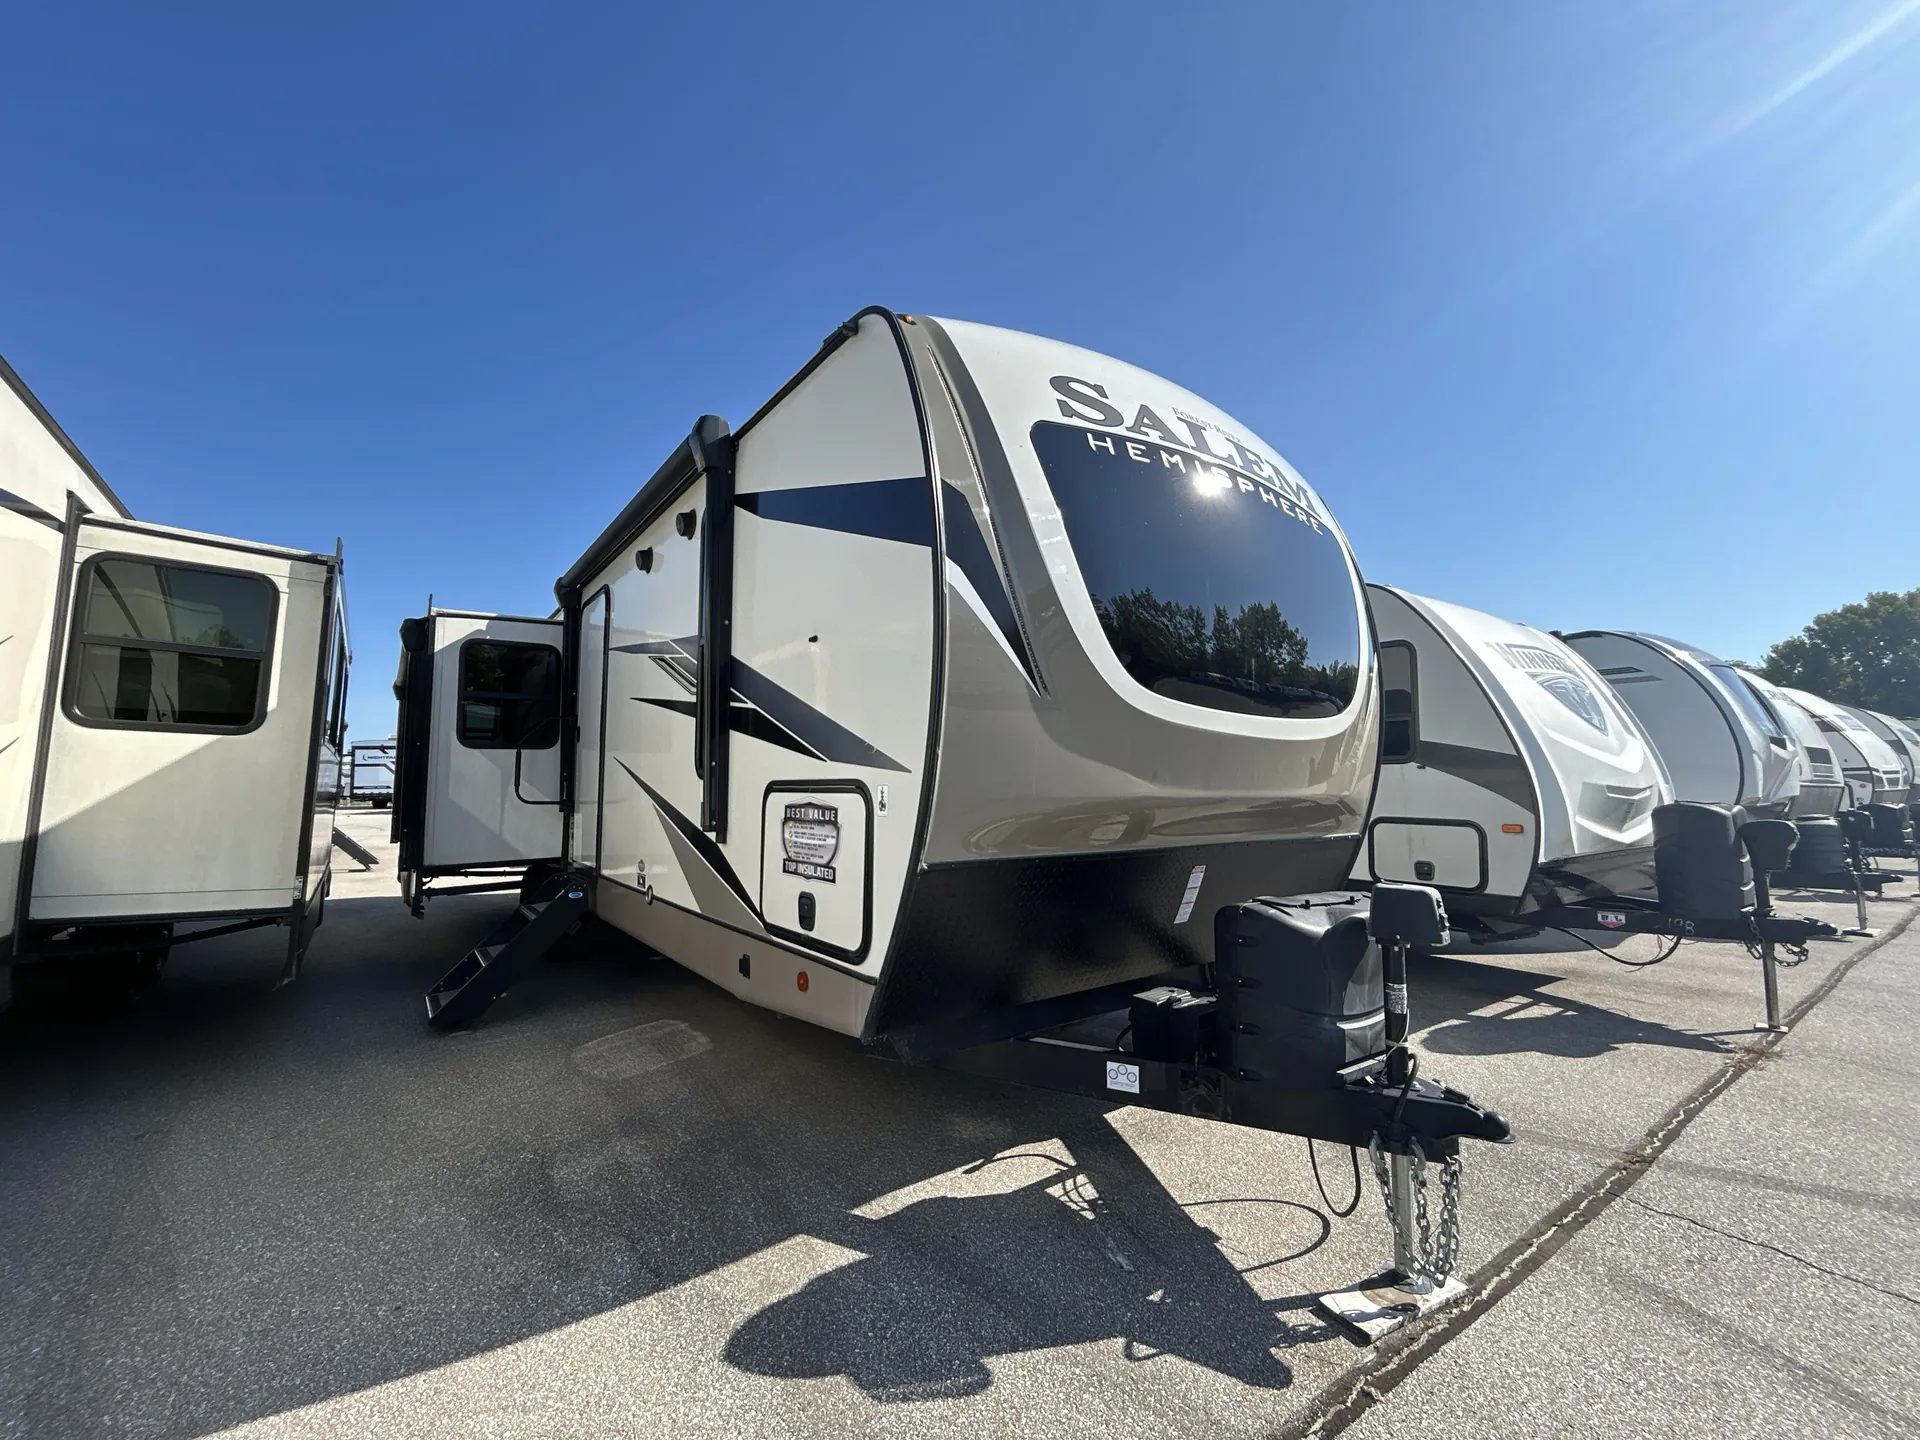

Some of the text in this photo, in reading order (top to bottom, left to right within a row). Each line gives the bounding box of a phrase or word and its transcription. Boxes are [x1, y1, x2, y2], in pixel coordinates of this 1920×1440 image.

[1049, 375, 1323, 520] SALEM
[1086, 432, 1324, 536] HEMISPHERE
[786, 807, 836, 821] BEST VALUE
[784, 861, 834, 880] TOP INSULATED
